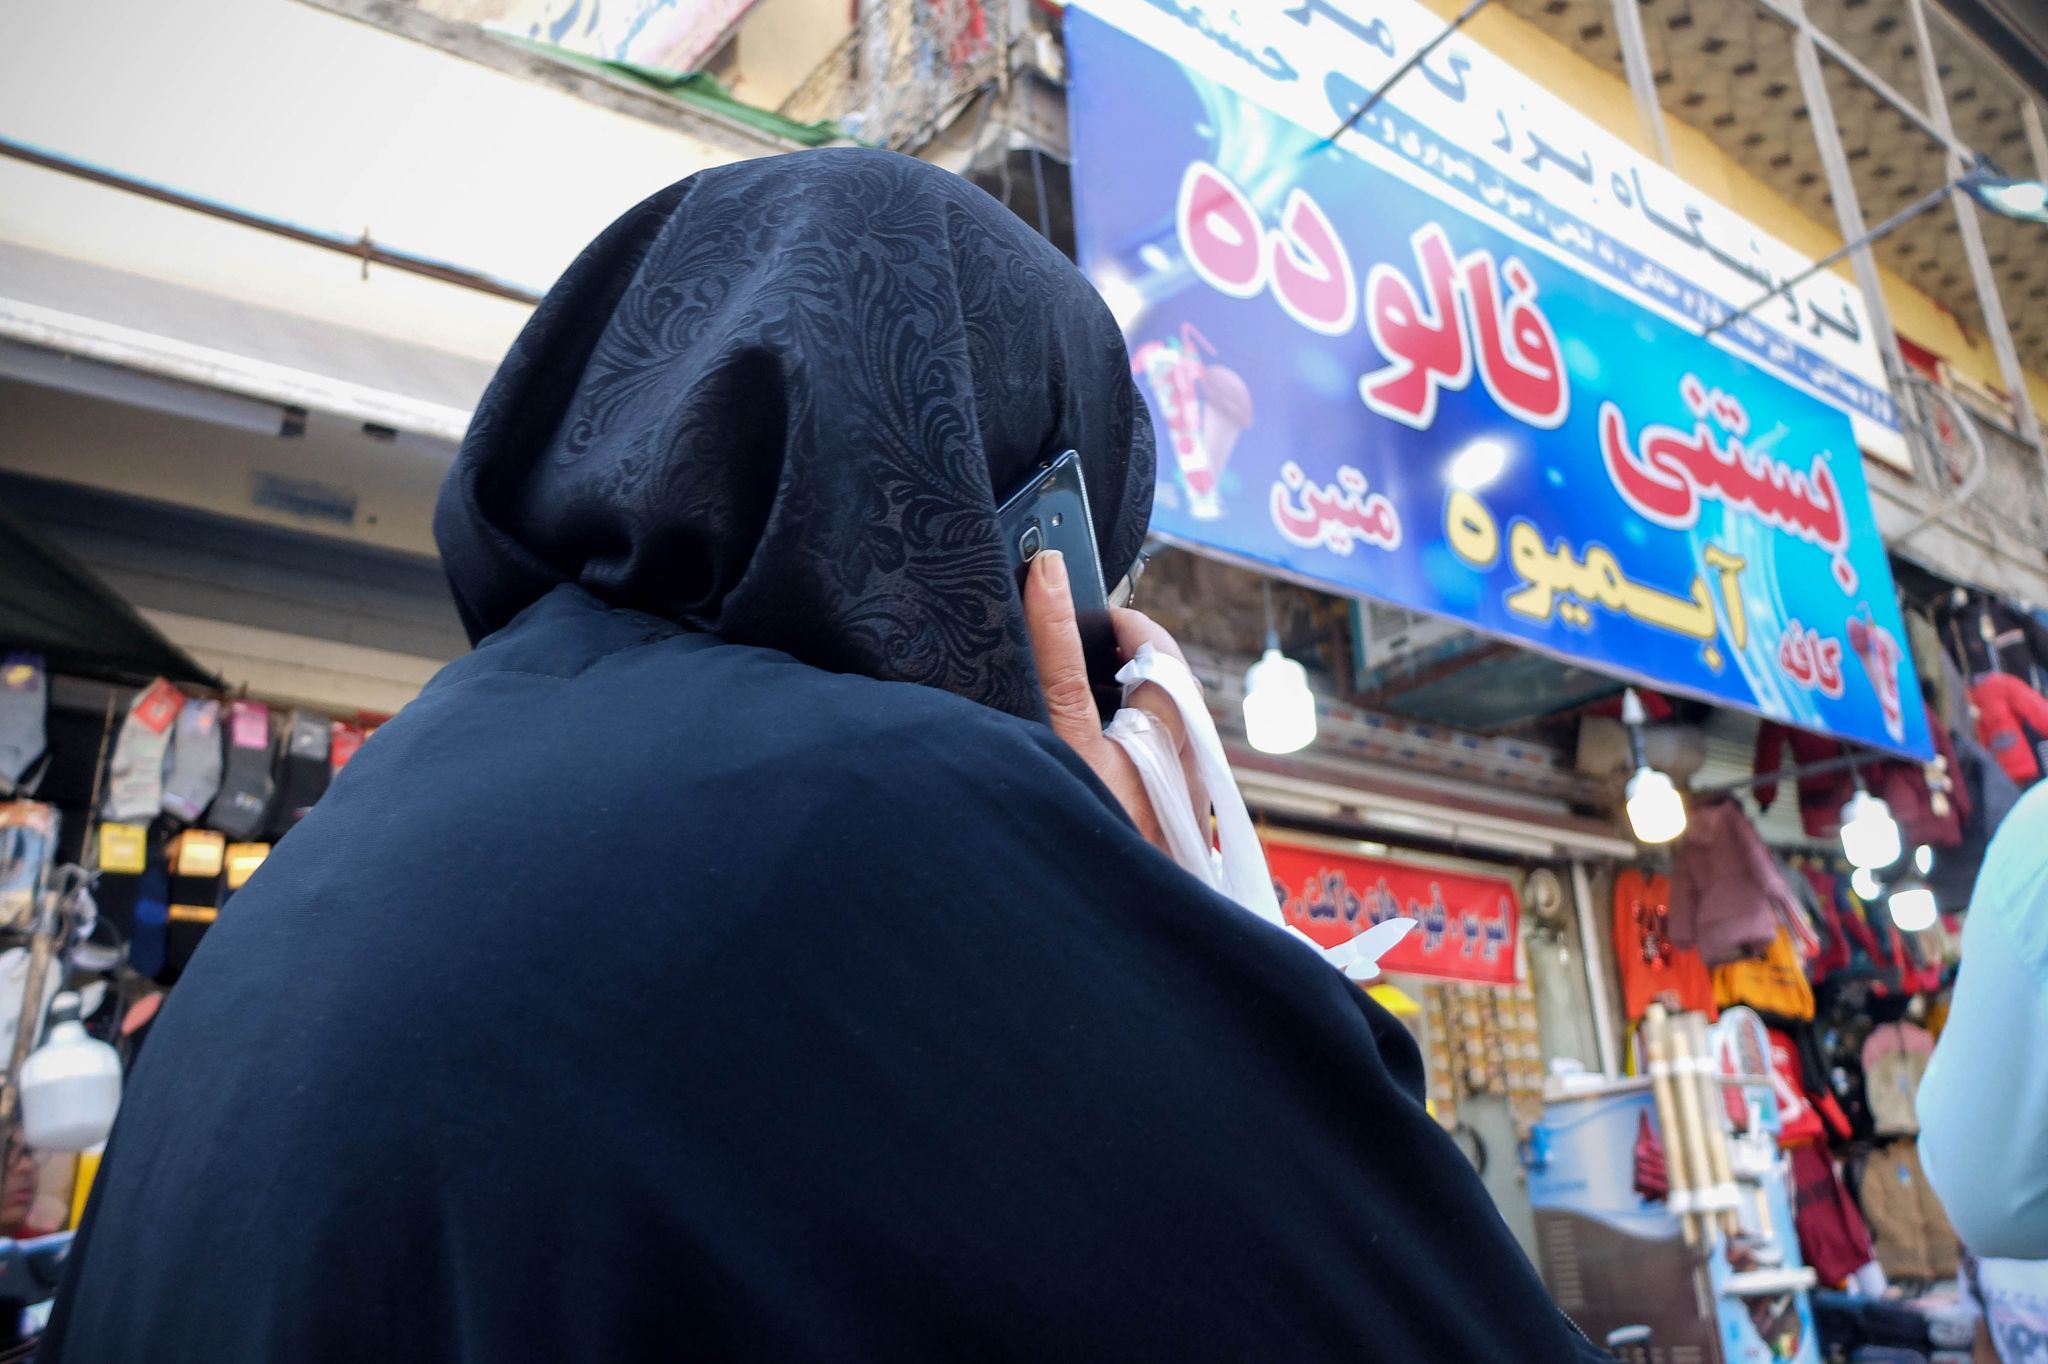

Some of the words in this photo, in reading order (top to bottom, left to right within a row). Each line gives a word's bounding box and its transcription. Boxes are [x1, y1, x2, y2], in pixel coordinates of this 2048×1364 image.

[1415, 48, 1597, 205] بزرگ
[1178, 163, 1569, 428] فالوده
[1611, 166, 1861, 343] فروشگاه
[1270, 460, 1401, 556] متین
[1600, 374, 1857, 595] بستنی
[1446, 490, 1747, 671] آبمیوه
